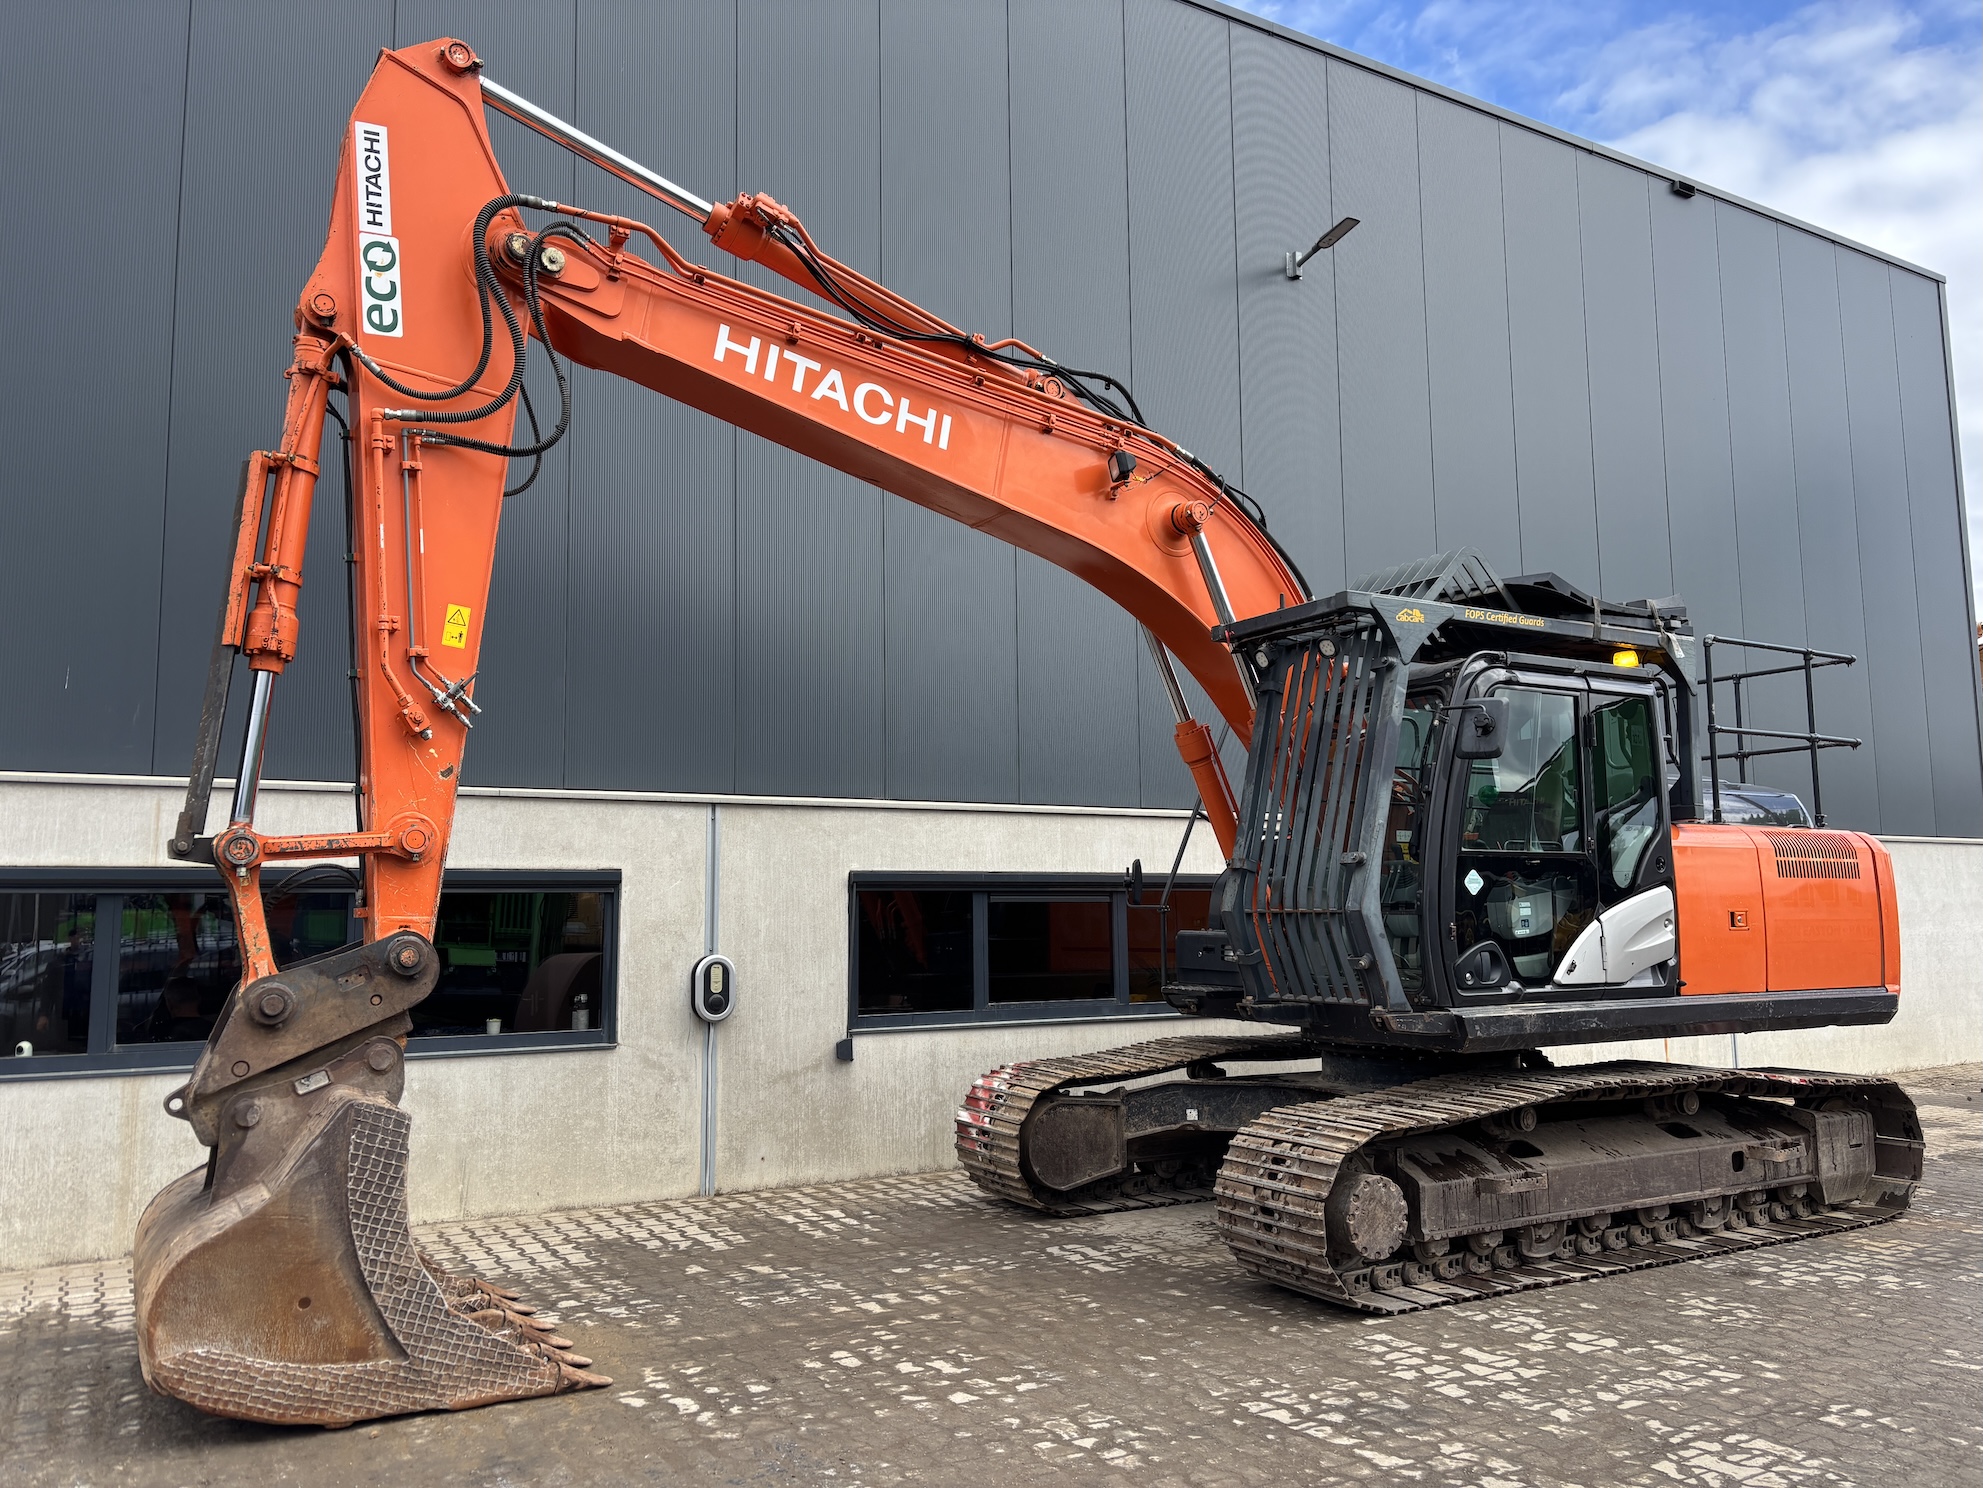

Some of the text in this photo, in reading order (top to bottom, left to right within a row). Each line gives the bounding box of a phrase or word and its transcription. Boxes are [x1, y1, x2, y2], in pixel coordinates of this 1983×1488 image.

[363, 129, 383, 227] HITACHI
[713, 323, 952, 450] HITACHI
[1465, 608, 1545, 627] FOPS Certified Guards
